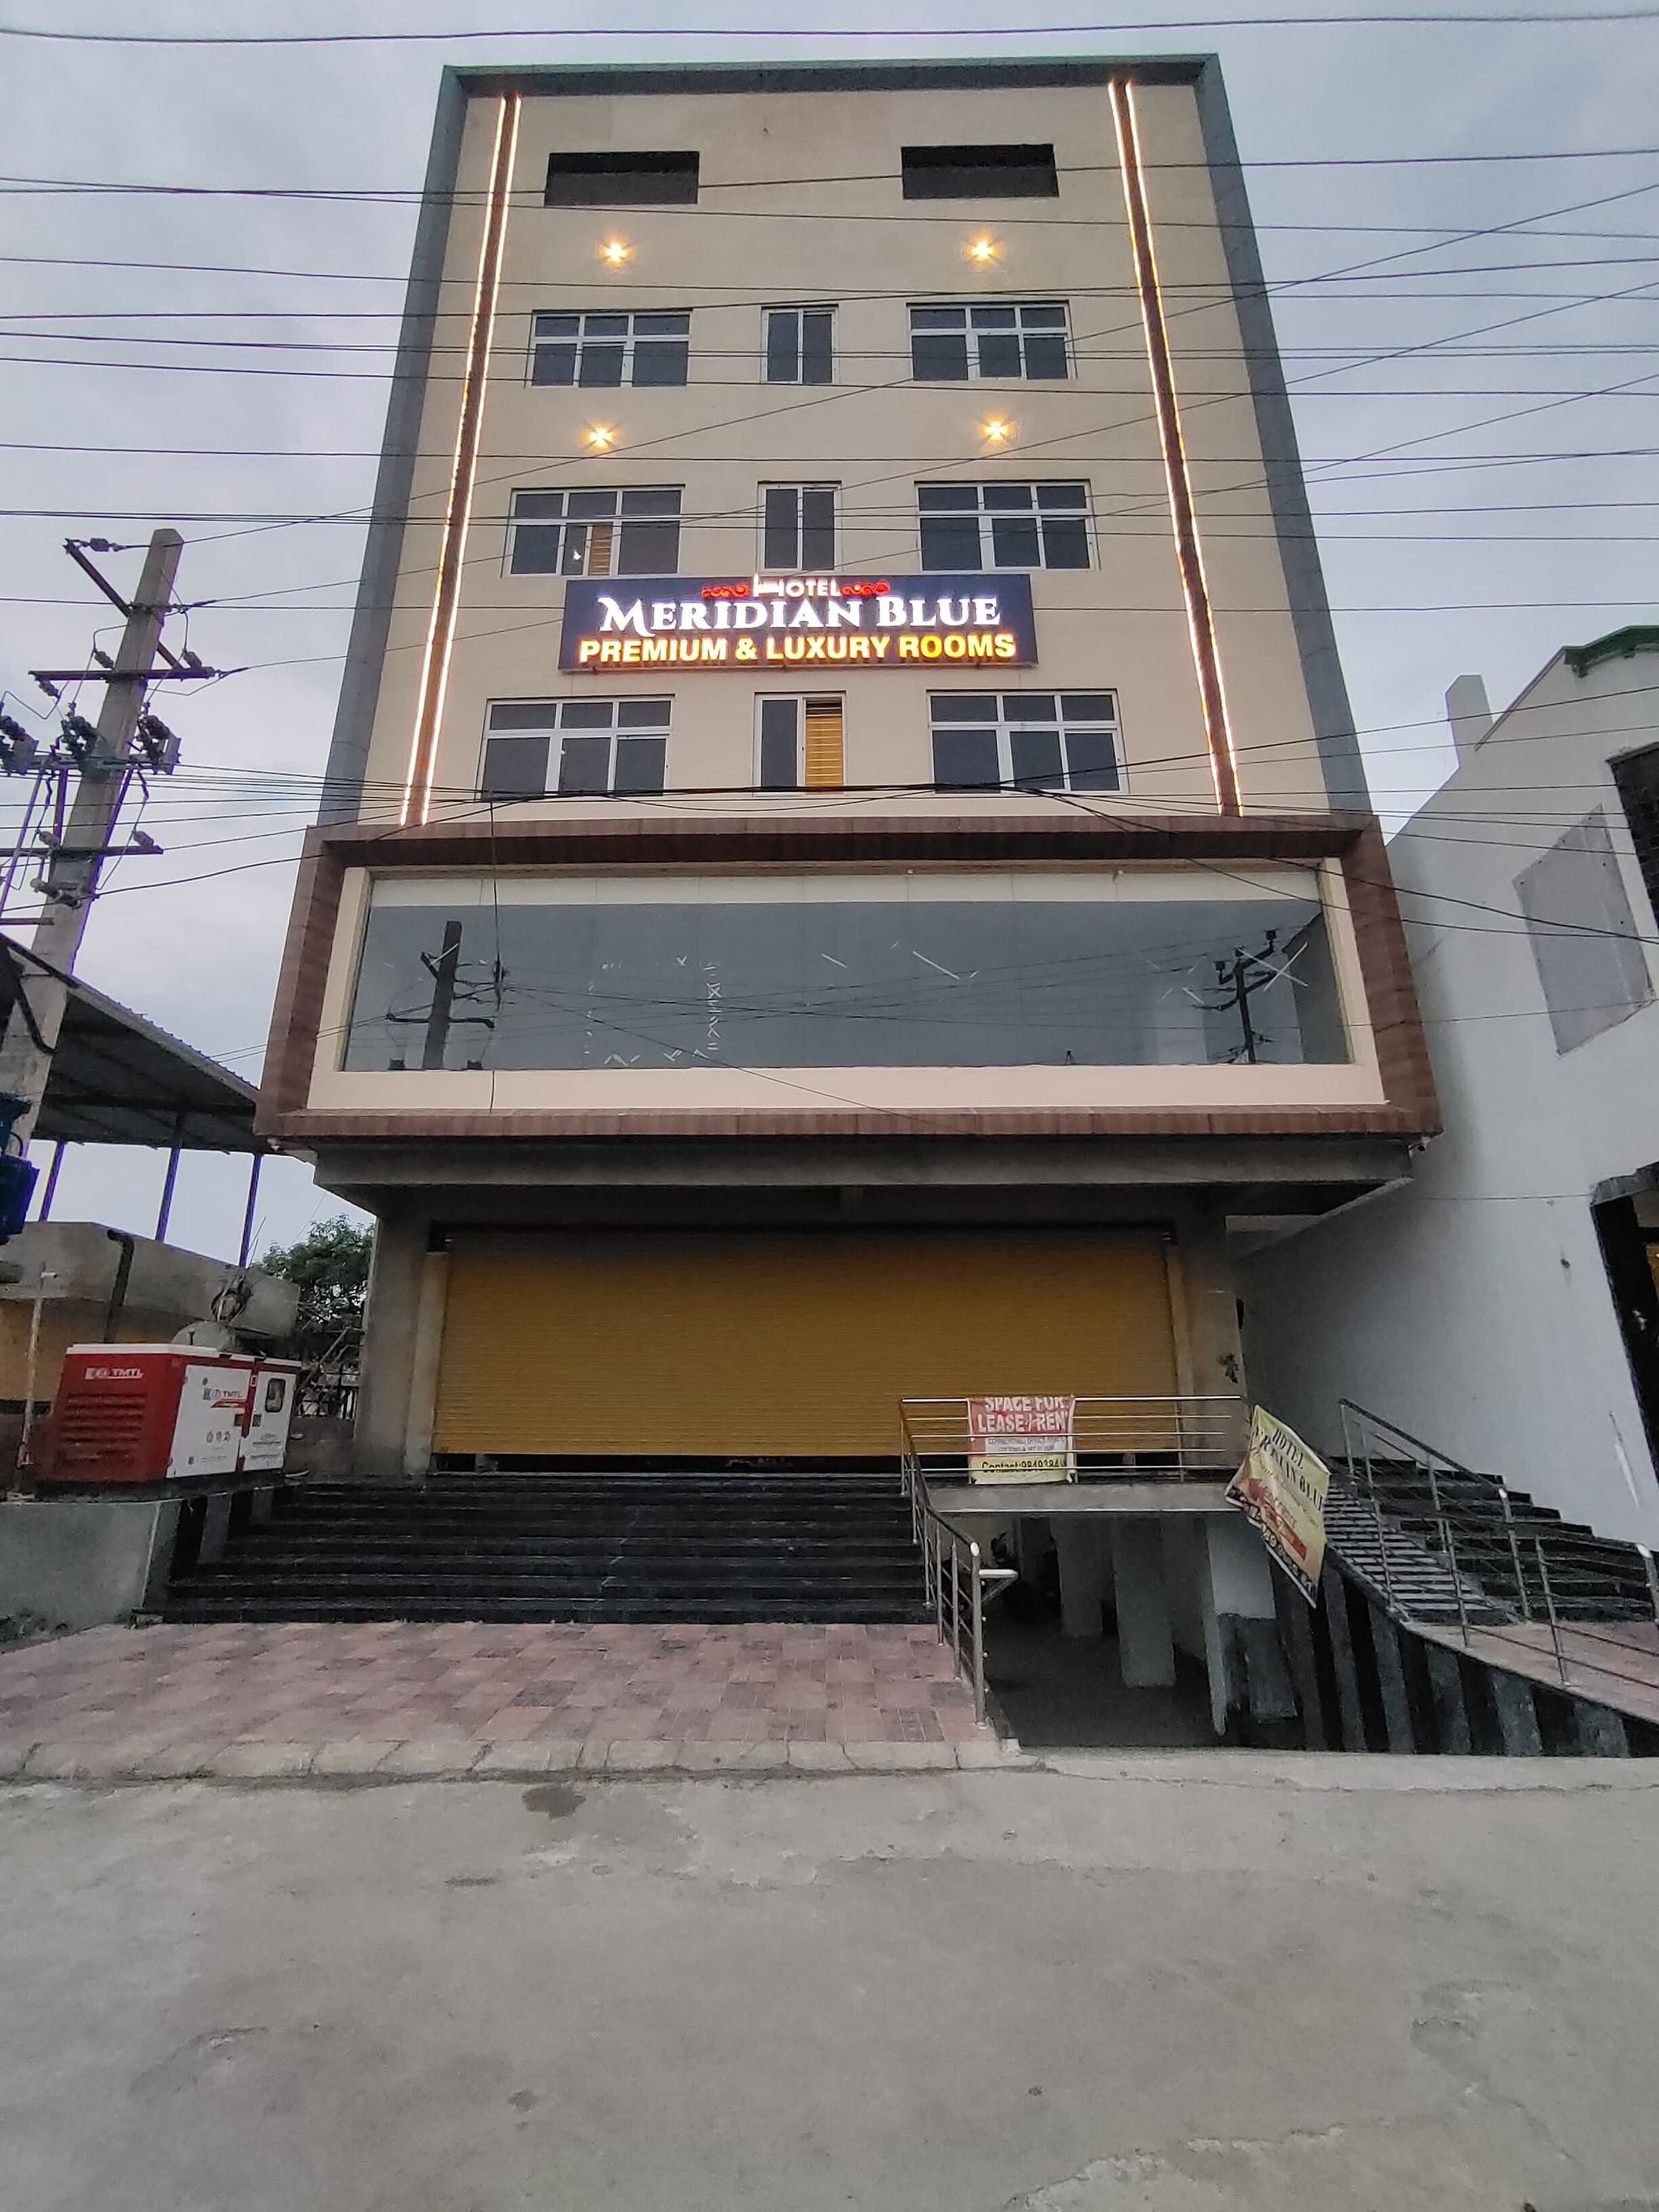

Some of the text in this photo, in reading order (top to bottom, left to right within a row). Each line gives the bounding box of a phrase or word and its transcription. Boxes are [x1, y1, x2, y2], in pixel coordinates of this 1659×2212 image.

[753, 574, 841, 598] HOTEL
[597, 595, 1000, 637] MERIDIAN BLUE
[579, 633, 1017, 663] PREMIUM & LUXURY ROOMS
[984, 1397, 1064, 1413] SPACE FOR
[978, 1413, 1025, 1432] LEASE
